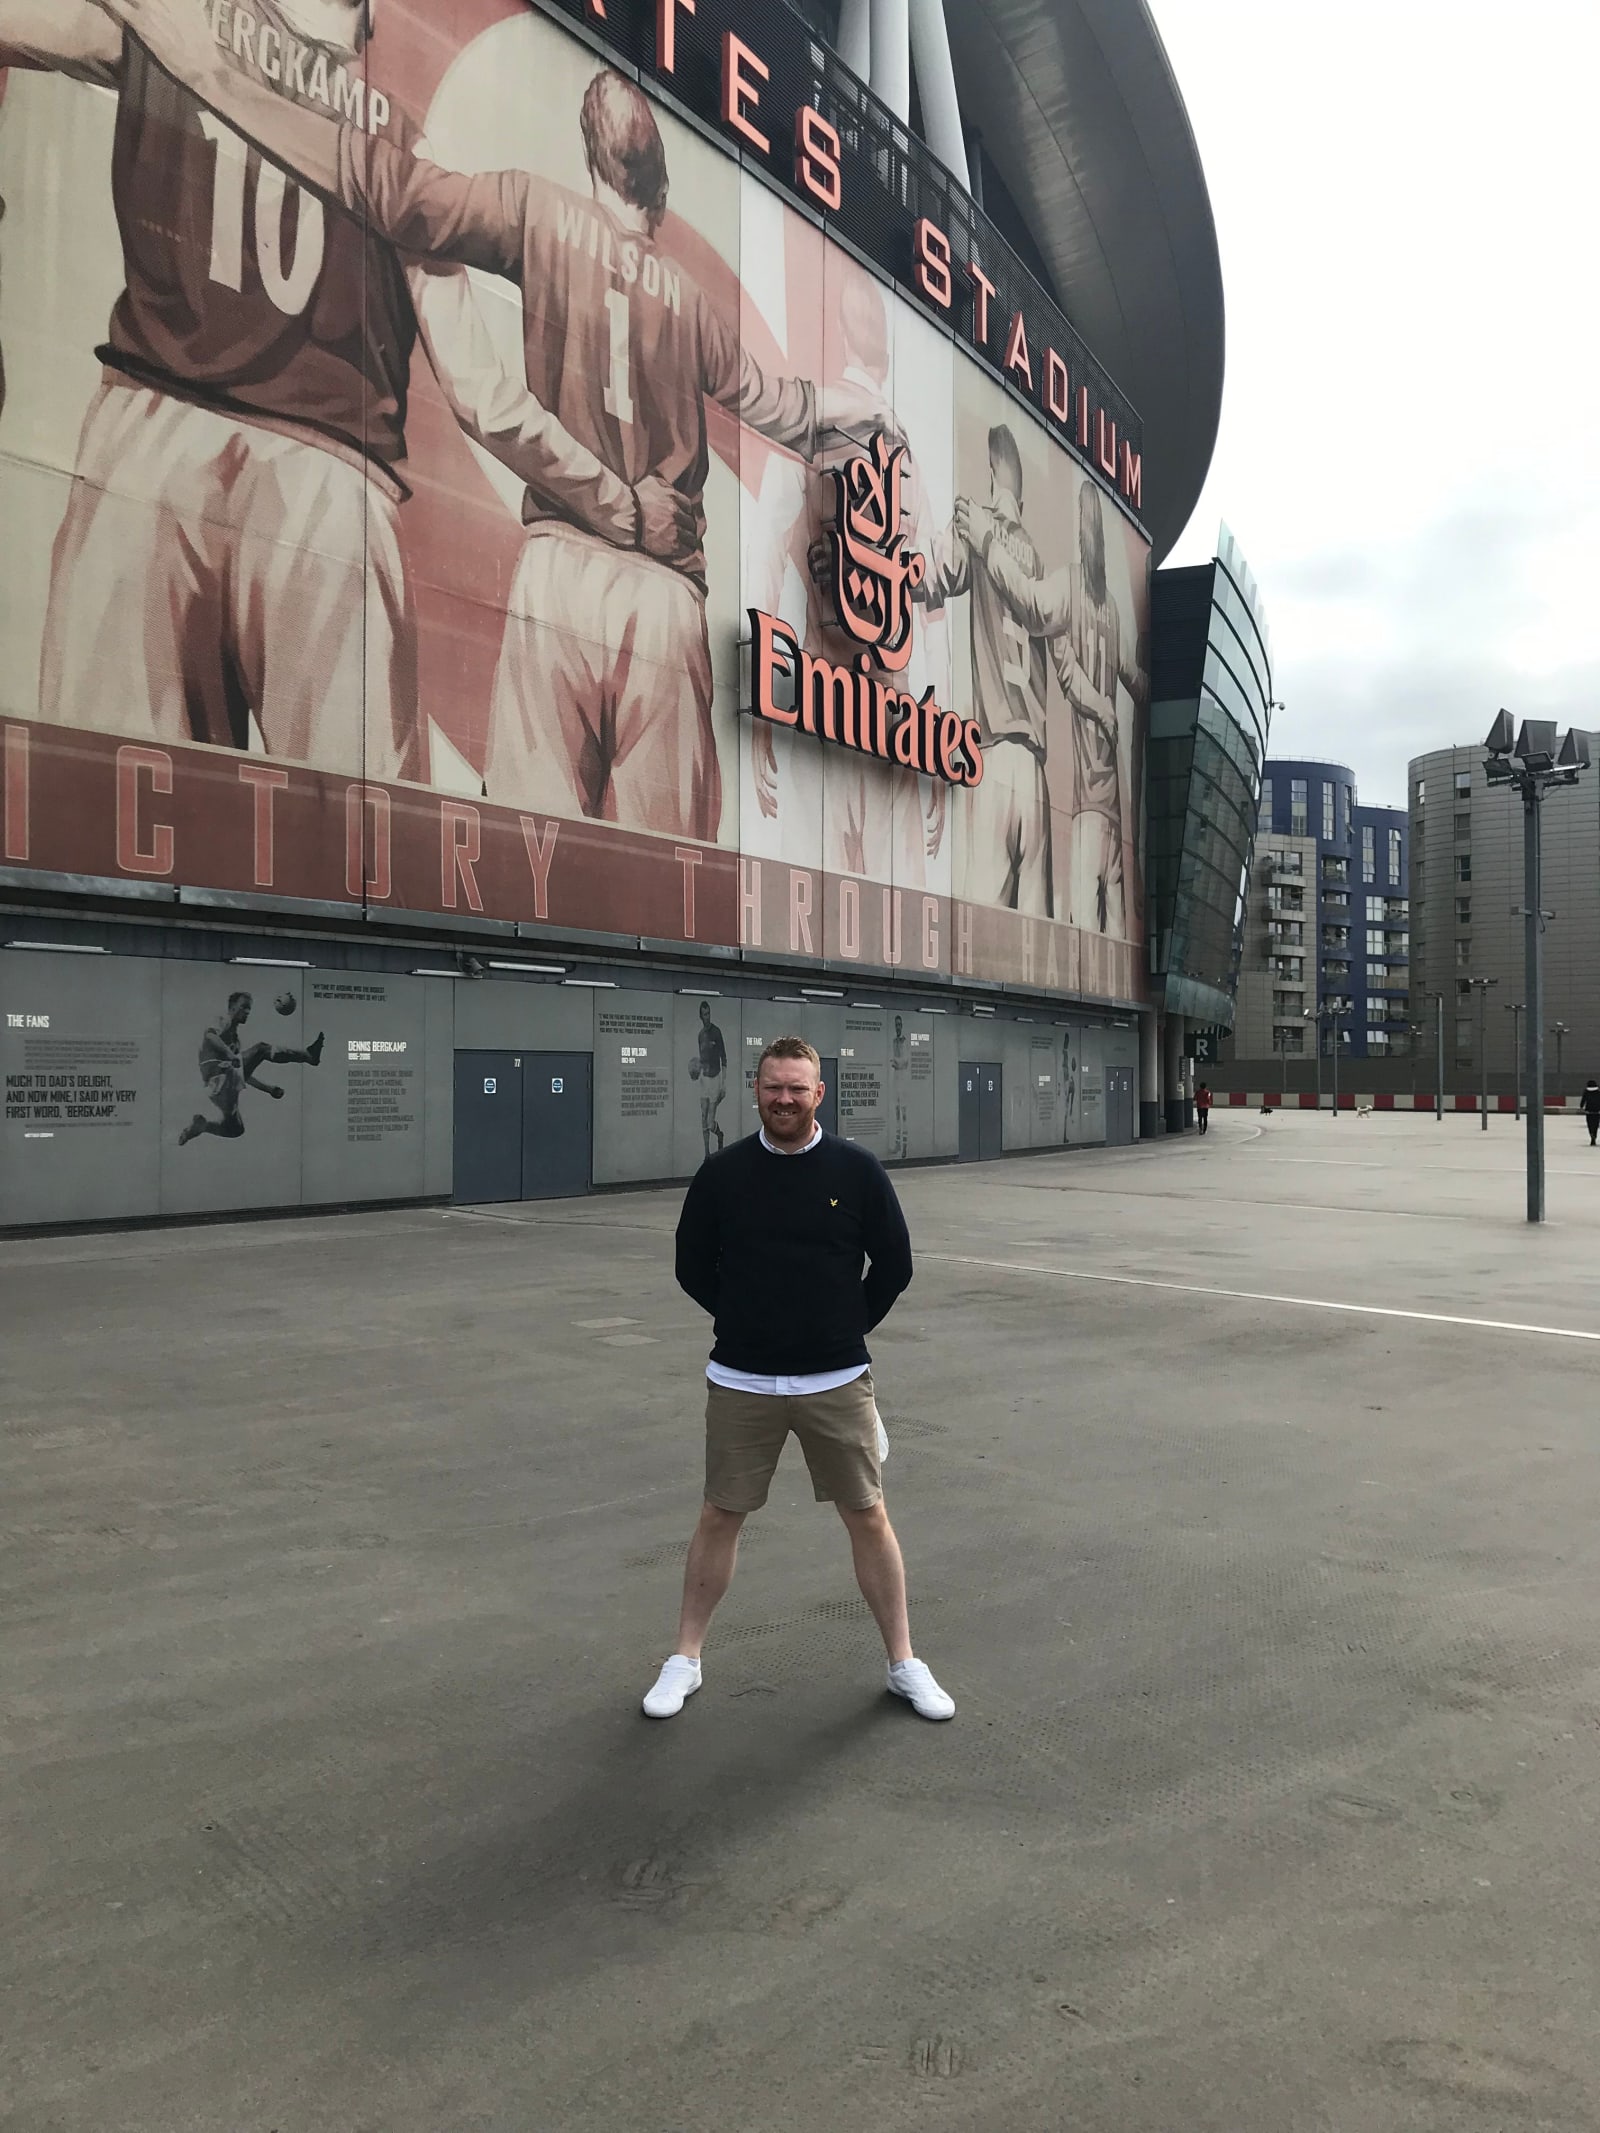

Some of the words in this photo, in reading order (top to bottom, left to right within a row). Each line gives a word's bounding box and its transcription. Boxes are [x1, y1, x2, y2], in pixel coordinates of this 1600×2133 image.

[198, 109, 325, 316] 10
[556, 200, 681, 317] WILSON
[584, 0, 841, 211] TES
[915, 217, 1142, 509] STADIUM
[604, 287, 633, 424] 1
[747, 608, 984, 788] Emirates
[675, 846, 973, 976] THROUGH
[6, 1014, 25, 1028] THE
[26, 1014, 50, 1028] FANS
[348, 1041, 371, 1052] DENNIS
[372, 1041, 407, 1053] BERGKAMP
[631, 1047, 648, 1057] WILSON
[1196, 1039, 1208, 1056] R
[6, 1075, 33, 1088] MUCH
[35, 1075, 46, 1088] TO
[48, 1075, 75, 1088] DAD'S
[77, 1075, 113, 1089] DELIGHT,
[6, 1090, 25, 1103] AND
[27, 1090, 49, 1103] NOW
[79, 1090, 99, 1103] SAID
[101, 1090, 114, 1103] MY
[115, 1090, 137, 1103] VERY
[6, 1105, 32, 1118] FIRST
[33, 1105, 62, 1119] WORD,
